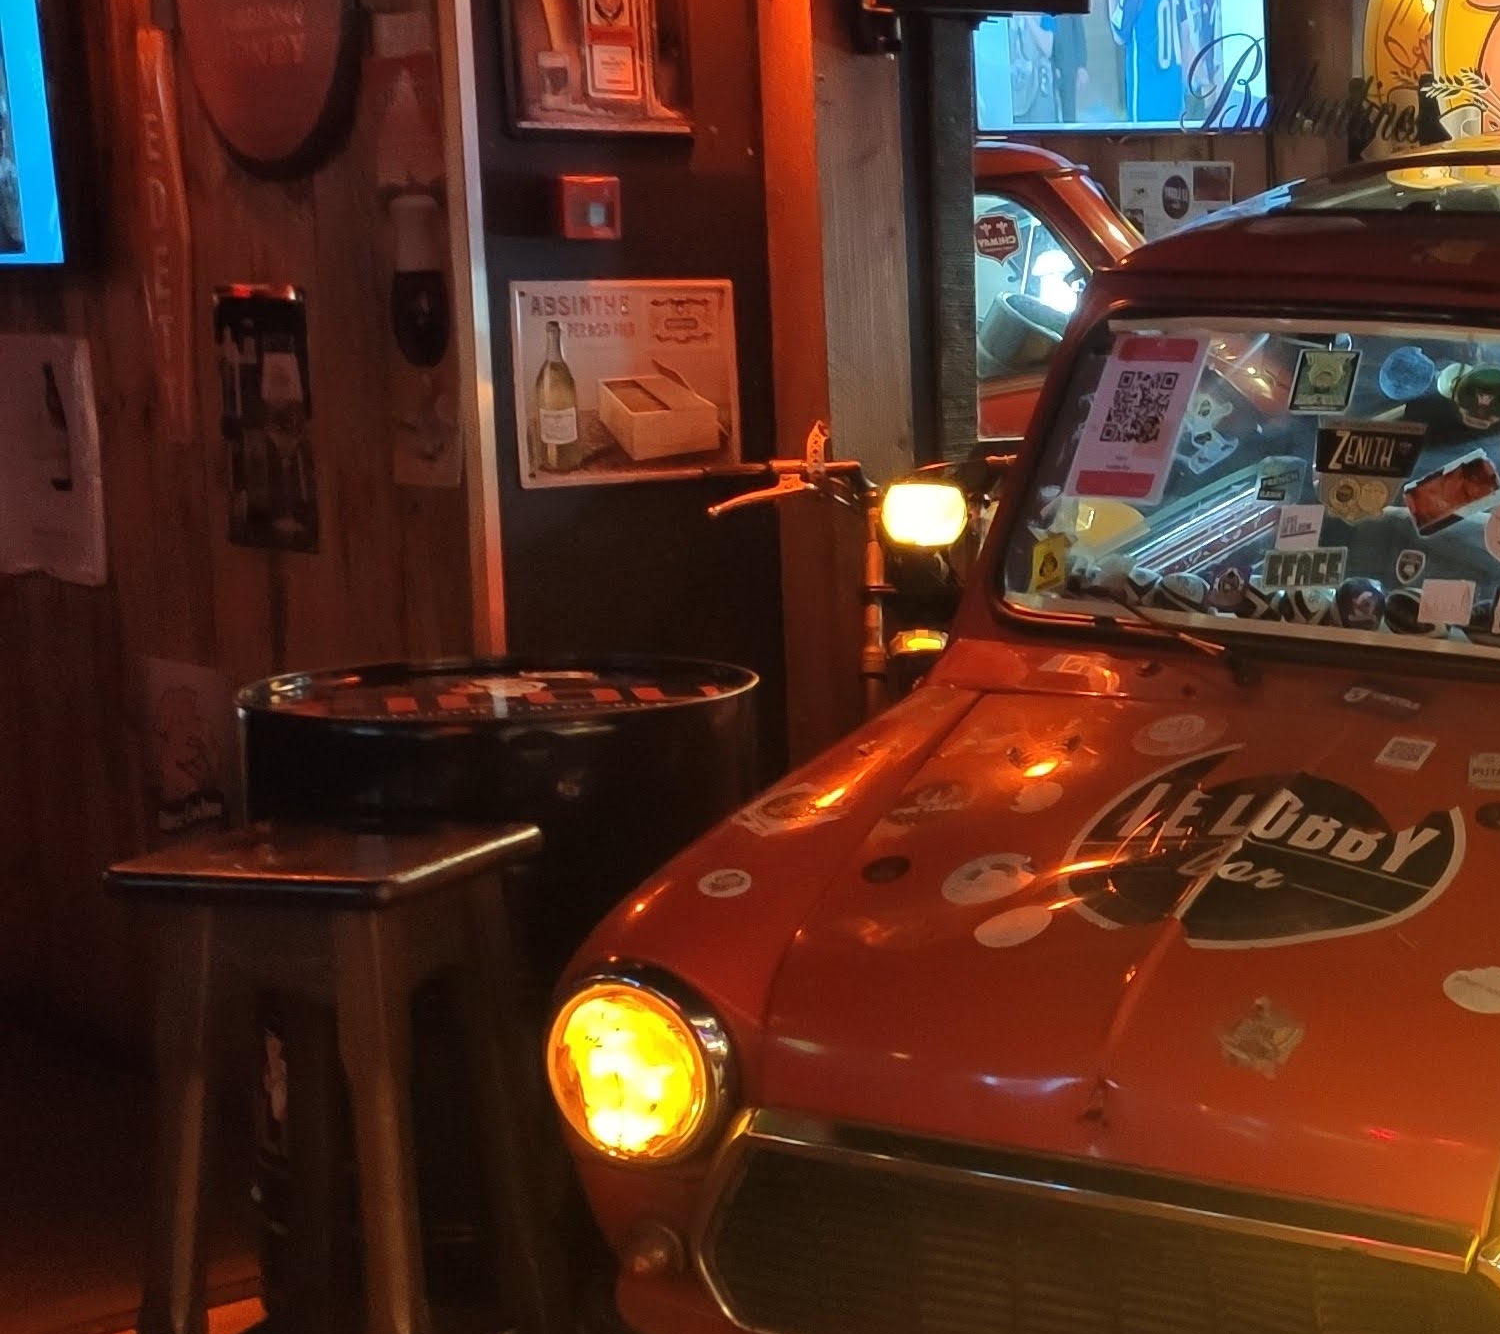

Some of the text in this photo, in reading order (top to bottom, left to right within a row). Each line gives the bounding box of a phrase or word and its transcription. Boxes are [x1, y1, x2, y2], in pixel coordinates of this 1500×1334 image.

[531, 295, 631, 316] ABSINTHE
[1328, 429, 1396, 470] ZENITH
[1116, 782, 1441, 873] LE LOBBY
